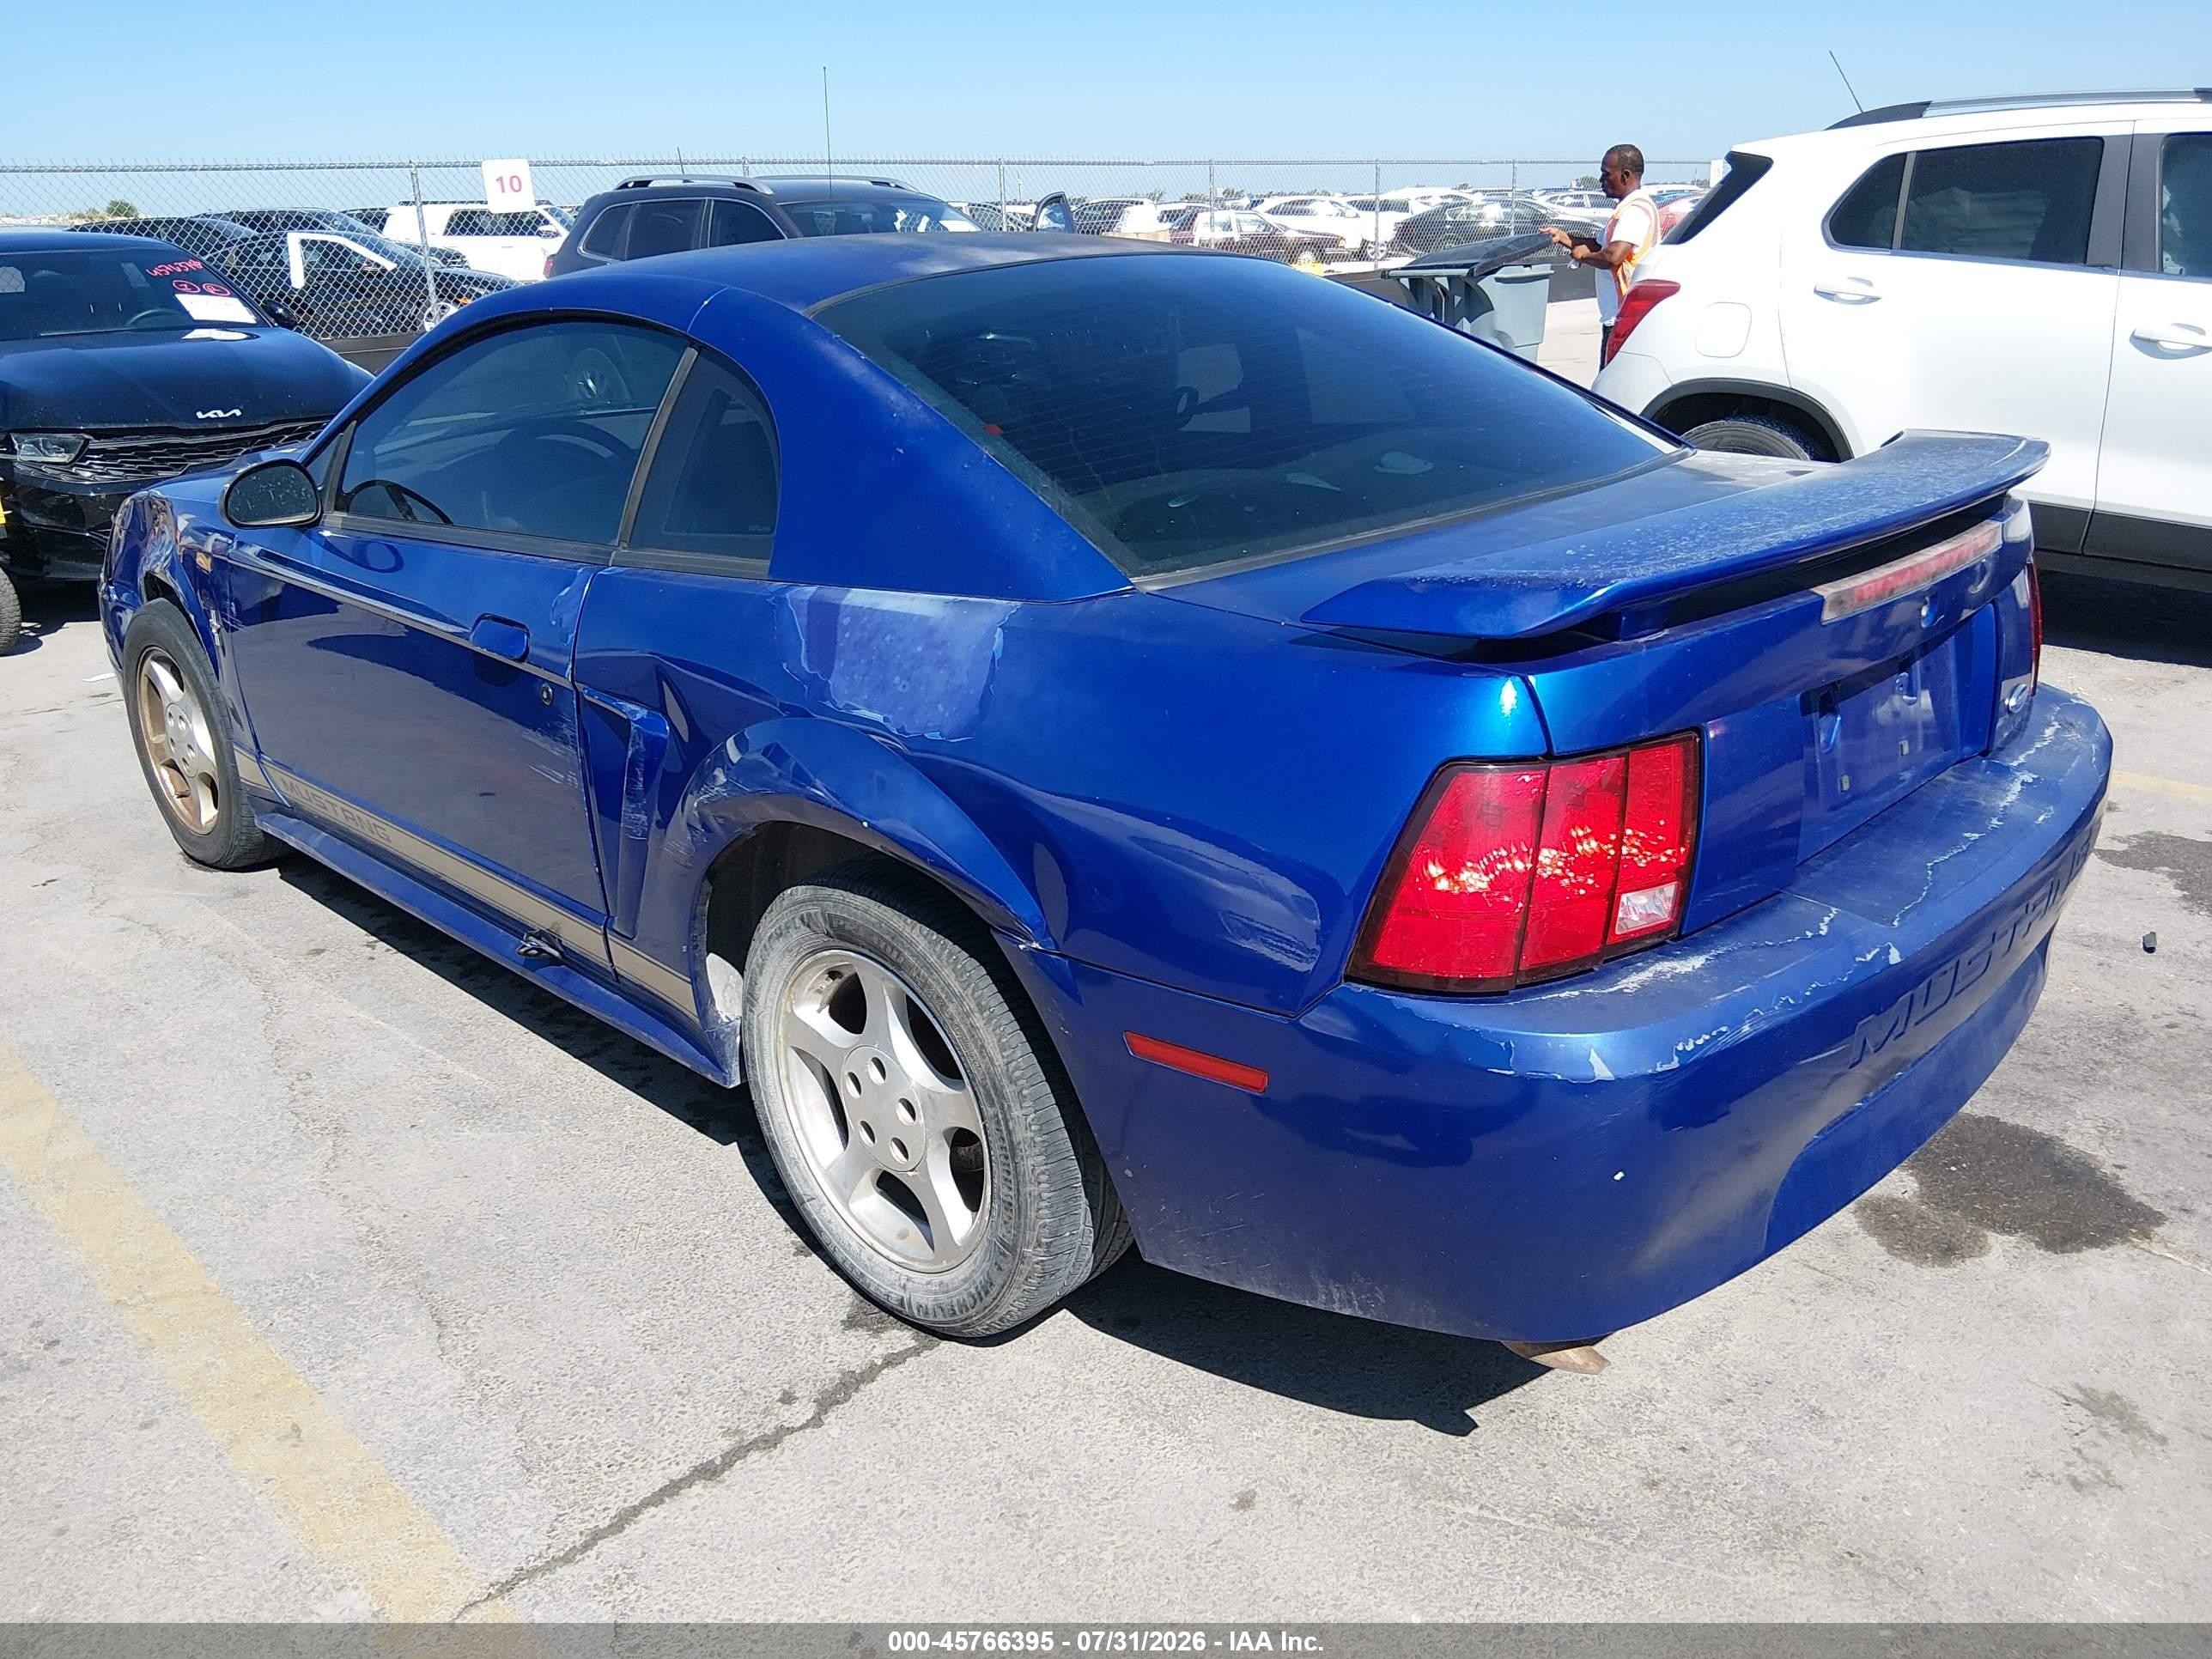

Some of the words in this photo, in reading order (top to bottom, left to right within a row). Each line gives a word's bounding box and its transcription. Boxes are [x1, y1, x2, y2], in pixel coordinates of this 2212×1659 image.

[495, 175, 522, 193] 10
[196, 409, 241, 419] KIA
[280, 777, 392, 842] MUSTANG
